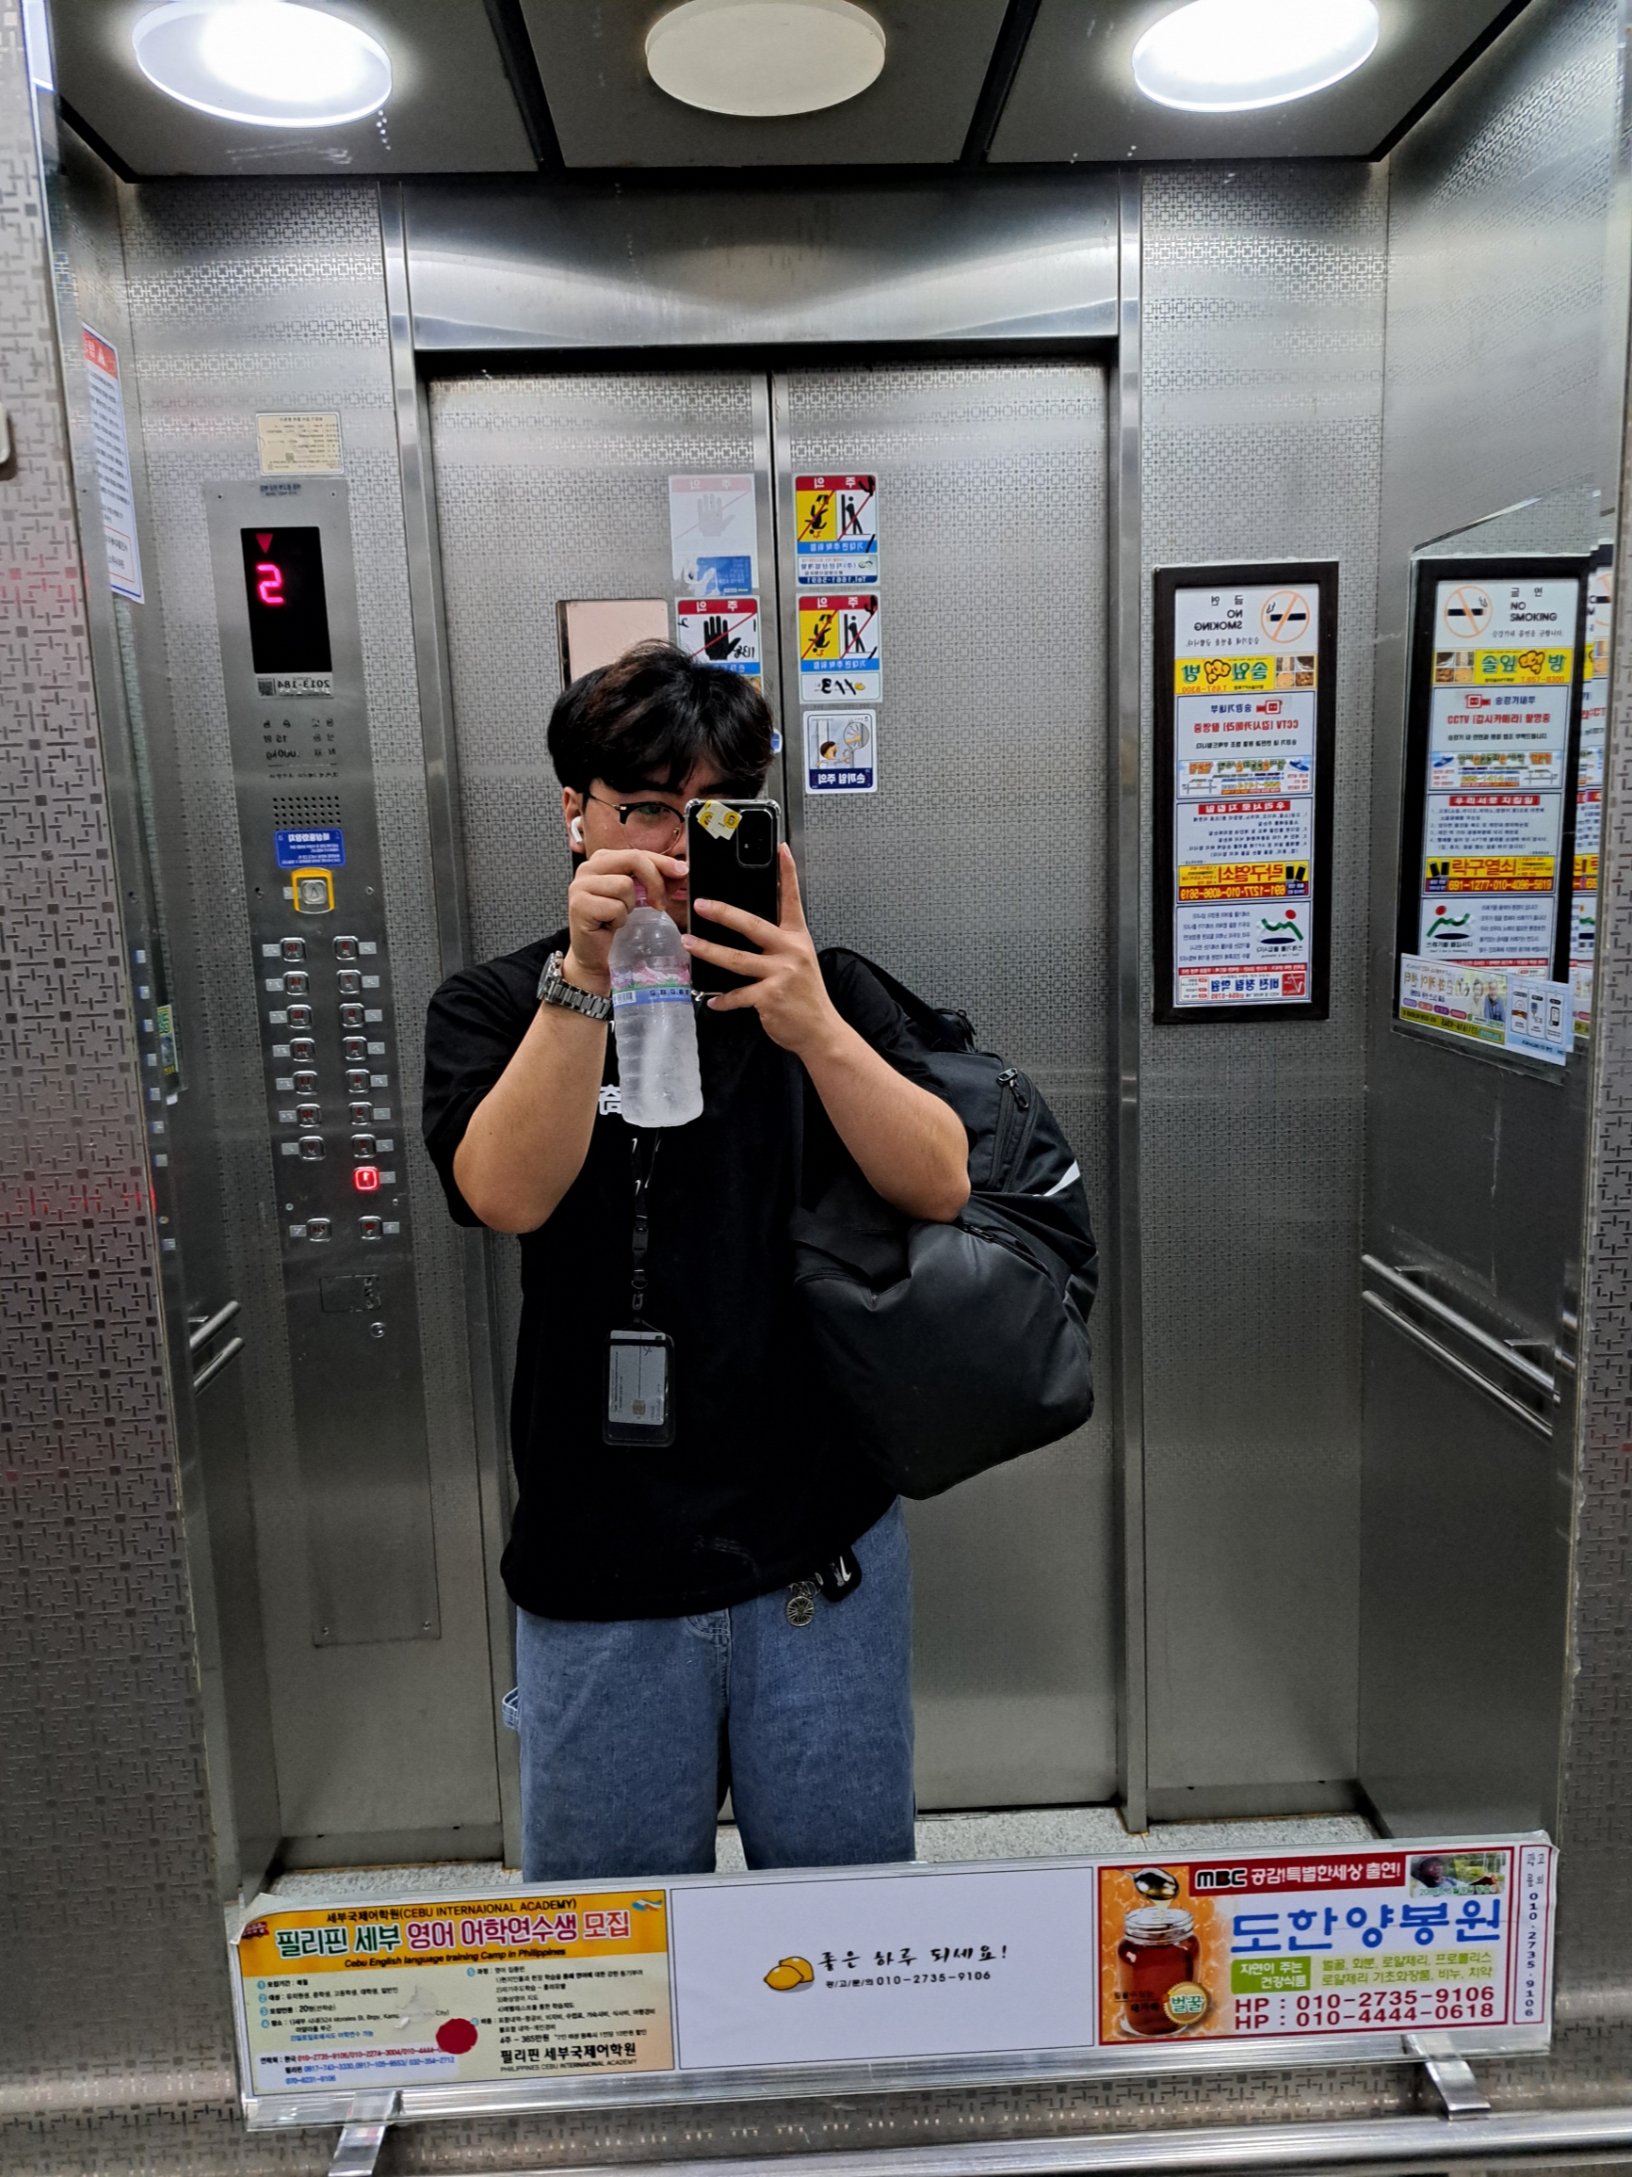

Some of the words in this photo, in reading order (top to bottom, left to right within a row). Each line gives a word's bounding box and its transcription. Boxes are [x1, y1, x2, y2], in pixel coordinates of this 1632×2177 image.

[1511, 602, 1526, 610] NO
[1510, 613, 1557, 622] SMOKING
[1448, 715, 1469, 724] CCTV
[1195, 1870, 1248, 1889] MBC
[520, 1898, 577, 1911] ACADEMY)
[275, 1926, 349, 1958] 필리핀
[354, 1923, 401, 1952] 세부
[406, 1920, 455, 1950] 영어
[461, 1913, 578, 1947] 어학연수생
[583, 1910, 630, 1939] 모집
[1230, 1898, 1501, 1953] 도한양봉원
[344, 1959, 367, 1968] Cebu
[369, 1956, 402, 1968] English
[404, 1954, 444, 1967] language
[446, 1953, 479, 1964] training
[481, 1950, 506, 1961] Camp
[508, 1950, 516, 1958] in
[518, 1948, 566, 1958] Philippines
[818, 1951, 860, 1971] 좋은
[874, 1948, 917, 1966] 하루
[930, 1945, 1007, 1963] 되세요!
[1240, 1962, 1275, 1976] 자연이
[1279, 1962, 1303, 1974] 주는
[1469, 1966, 1493, 1979] 치약
[1261, 1976, 1307, 1989] 건강식품
[1169, 1995, 1204, 2013] 벌꿀
[1235, 1998, 1270, 2013] HP
[1296, 1986, 1495, 2010] 010-2735-9106
[1235, 2014, 1270, 2030] HP
[1296, 2003, 1494, 2027] 010-4444-0618
[501, 2048, 540, 2064] 필리핀
[544, 2043, 636, 2061] 세부국제어학원
